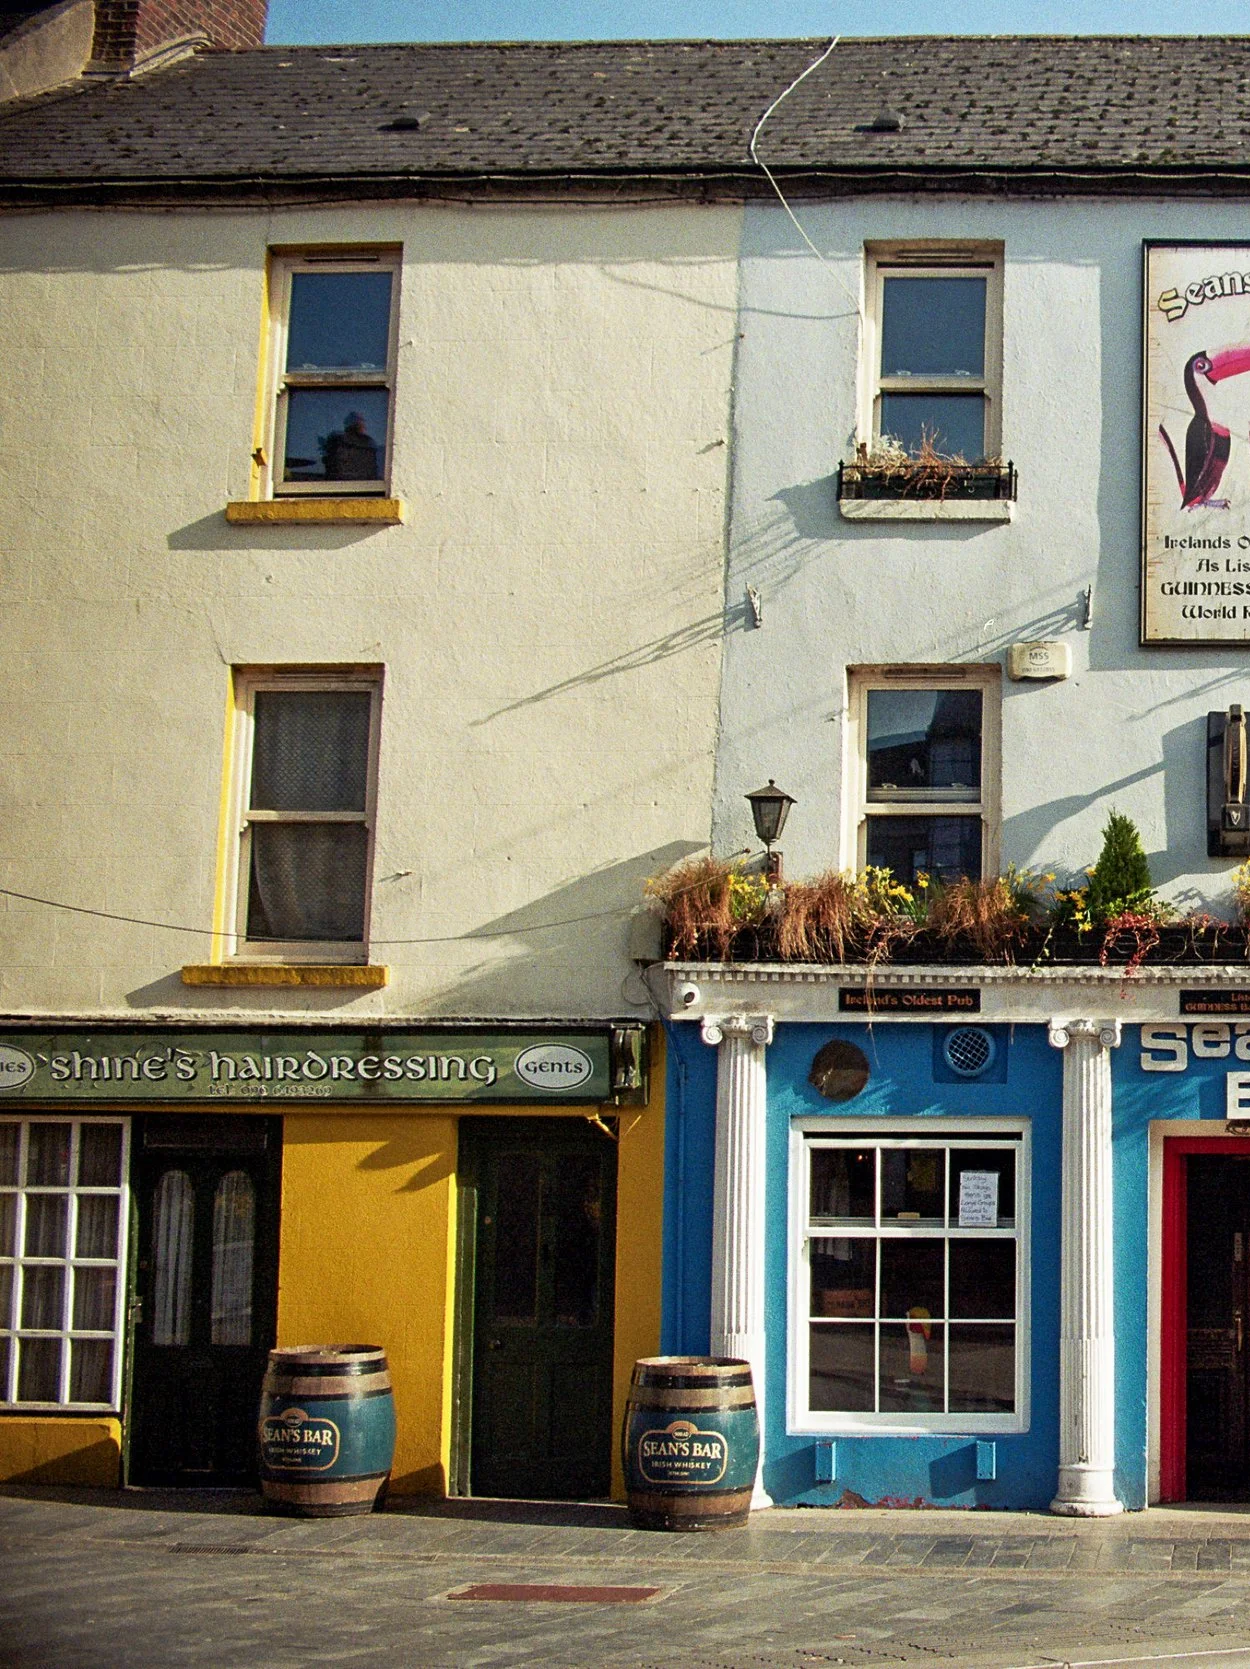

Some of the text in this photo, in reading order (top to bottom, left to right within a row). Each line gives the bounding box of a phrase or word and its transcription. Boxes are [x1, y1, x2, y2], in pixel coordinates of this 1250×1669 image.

[1164, 535, 1231, 549] Irelands
[1196, 558, 1220, 573] As
[1181, 605, 1237, 619] World
[1029, 652, 1050, 660] MSS
[902, 993, 943, 1005] Oldest
[947, 994, 973, 1006] Pub
[263, 1429, 333, 1446] SEAN'S BAR
[643, 1440, 722, 1459] SEAN'S BAR
[651, 1461, 712, 1470] IRISH WHISKEY
